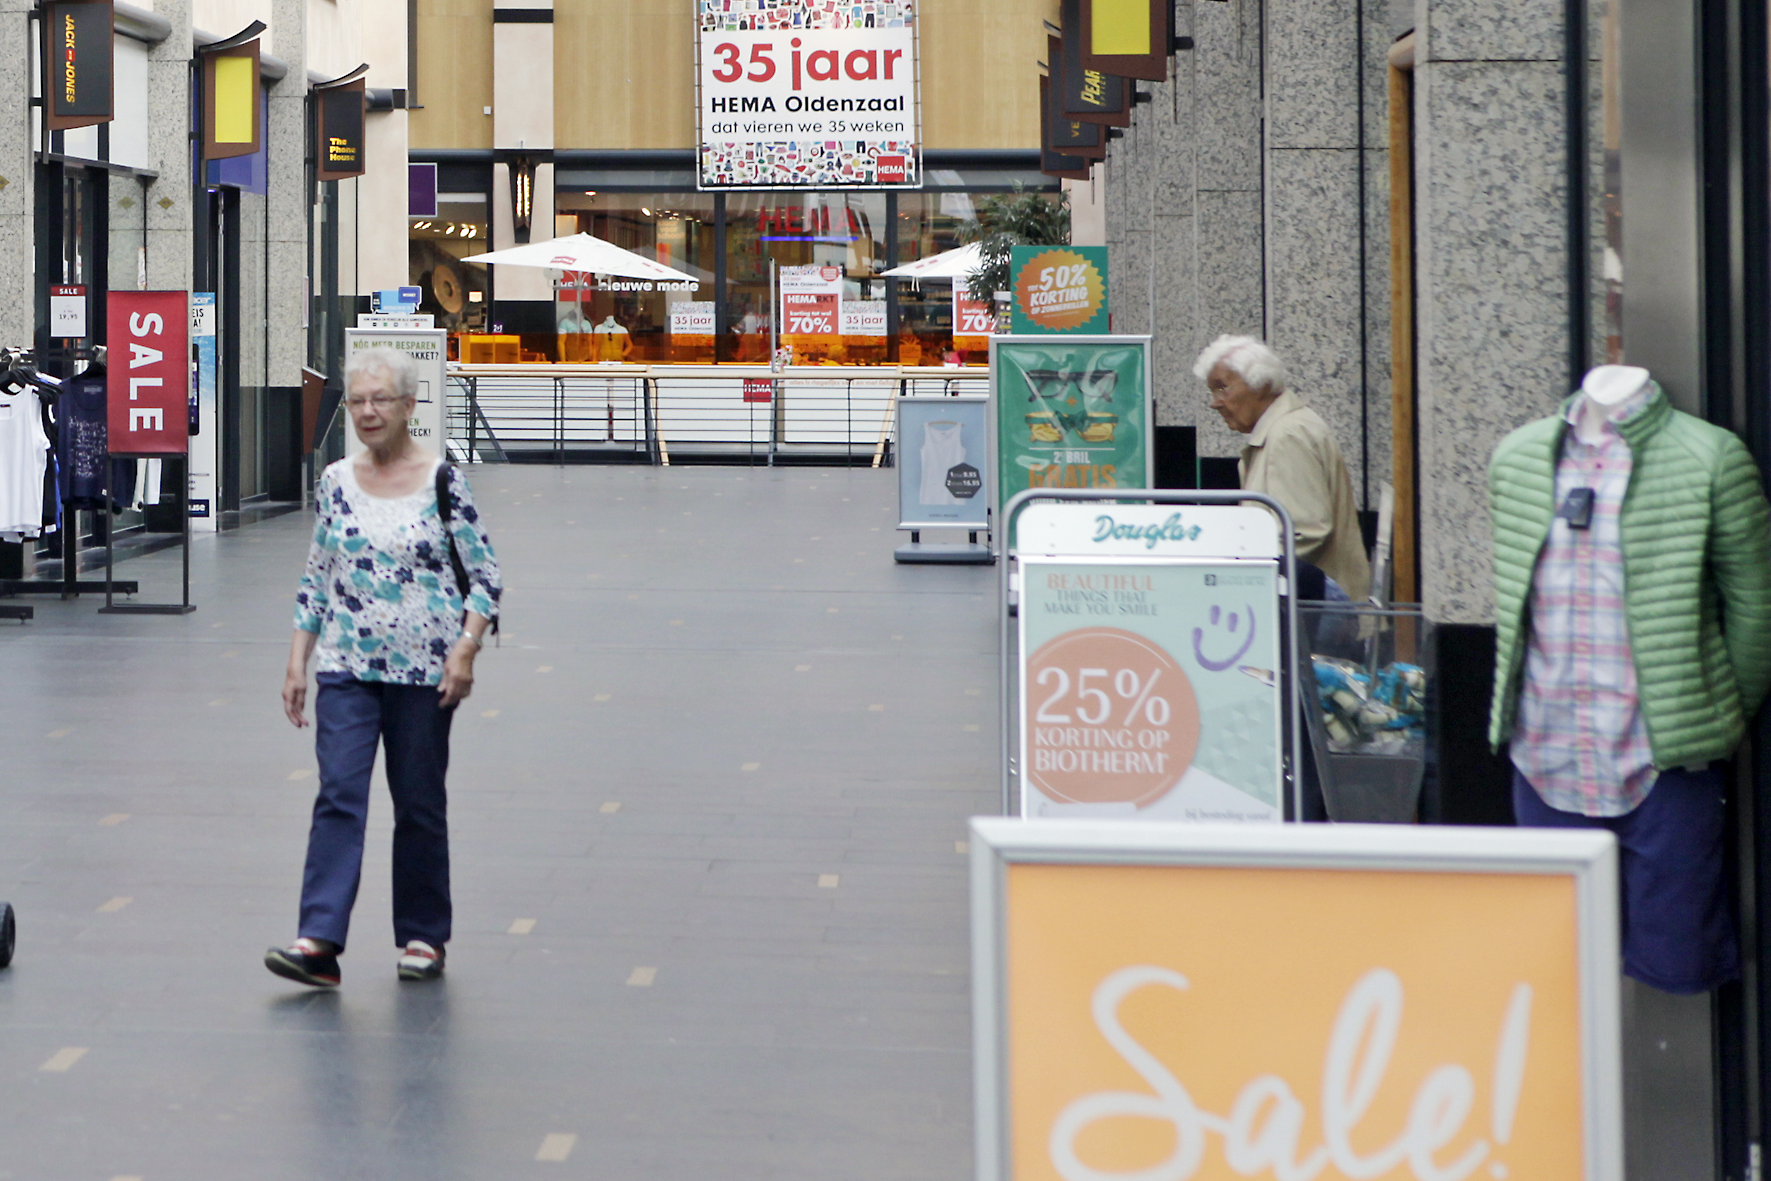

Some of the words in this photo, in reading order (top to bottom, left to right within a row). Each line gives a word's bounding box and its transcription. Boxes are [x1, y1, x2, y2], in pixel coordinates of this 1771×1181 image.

[65, 14, 75, 49] JACK
[712, 42, 776, 83] 35
[790, 37, 902, 91] jaar
[65, 61, 75, 103] JONES
[711, 97, 776, 113] HEMA
[785, 95, 904, 112] Oldenzaal
[711, 122, 738, 134] dat
[743, 121, 793, 133] vieren
[798, 123, 822, 132] we
[829, 121, 846, 132] 35
[850, 120, 904, 132] weken
[329, 137, 347, 145] The
[878, 165, 904, 174] HEMA
[758, 206, 858, 232] HEMA
[599, 280, 652, 292] nieuwe
[657, 280, 699, 292] mode
[1039, 264, 1087, 291] 50%
[787, 294, 835, 304] HEMARKT
[1030, 286, 1088, 307] KORTING
[675, 316, 688, 325] 35
[690, 315, 712, 326] jaar
[790, 317, 832, 333] 70%
[846, 315, 859, 324] 35
[861, 314, 884, 325] jaar
[395, 340, 436, 350] BESPAREN
[407, 351, 439, 361] AKKET?
[129, 311, 164, 432] SALE
[744, 384, 771, 393] HEMA
[1066, 451, 1091, 464] BRIL
[1029, 464, 1117, 489] GRATIS
[1092, 512, 1202, 549] Douglas
[1046, 573, 1156, 592] BEAUTIFUL
[1056, 590, 1109, 603] THINGS
[1113, 591, 1147, 604] THAT
[1044, 602, 1081, 615] MAKE
[1086, 602, 1114, 615] YOU
[1118, 603, 1158, 616] SMILE
[1035, 666, 1171, 727] 25%
[1035, 726, 1134, 749] KORTING
[1137, 728, 1170, 750] OP
[1049, 964, 1533, 1181] Sale!
